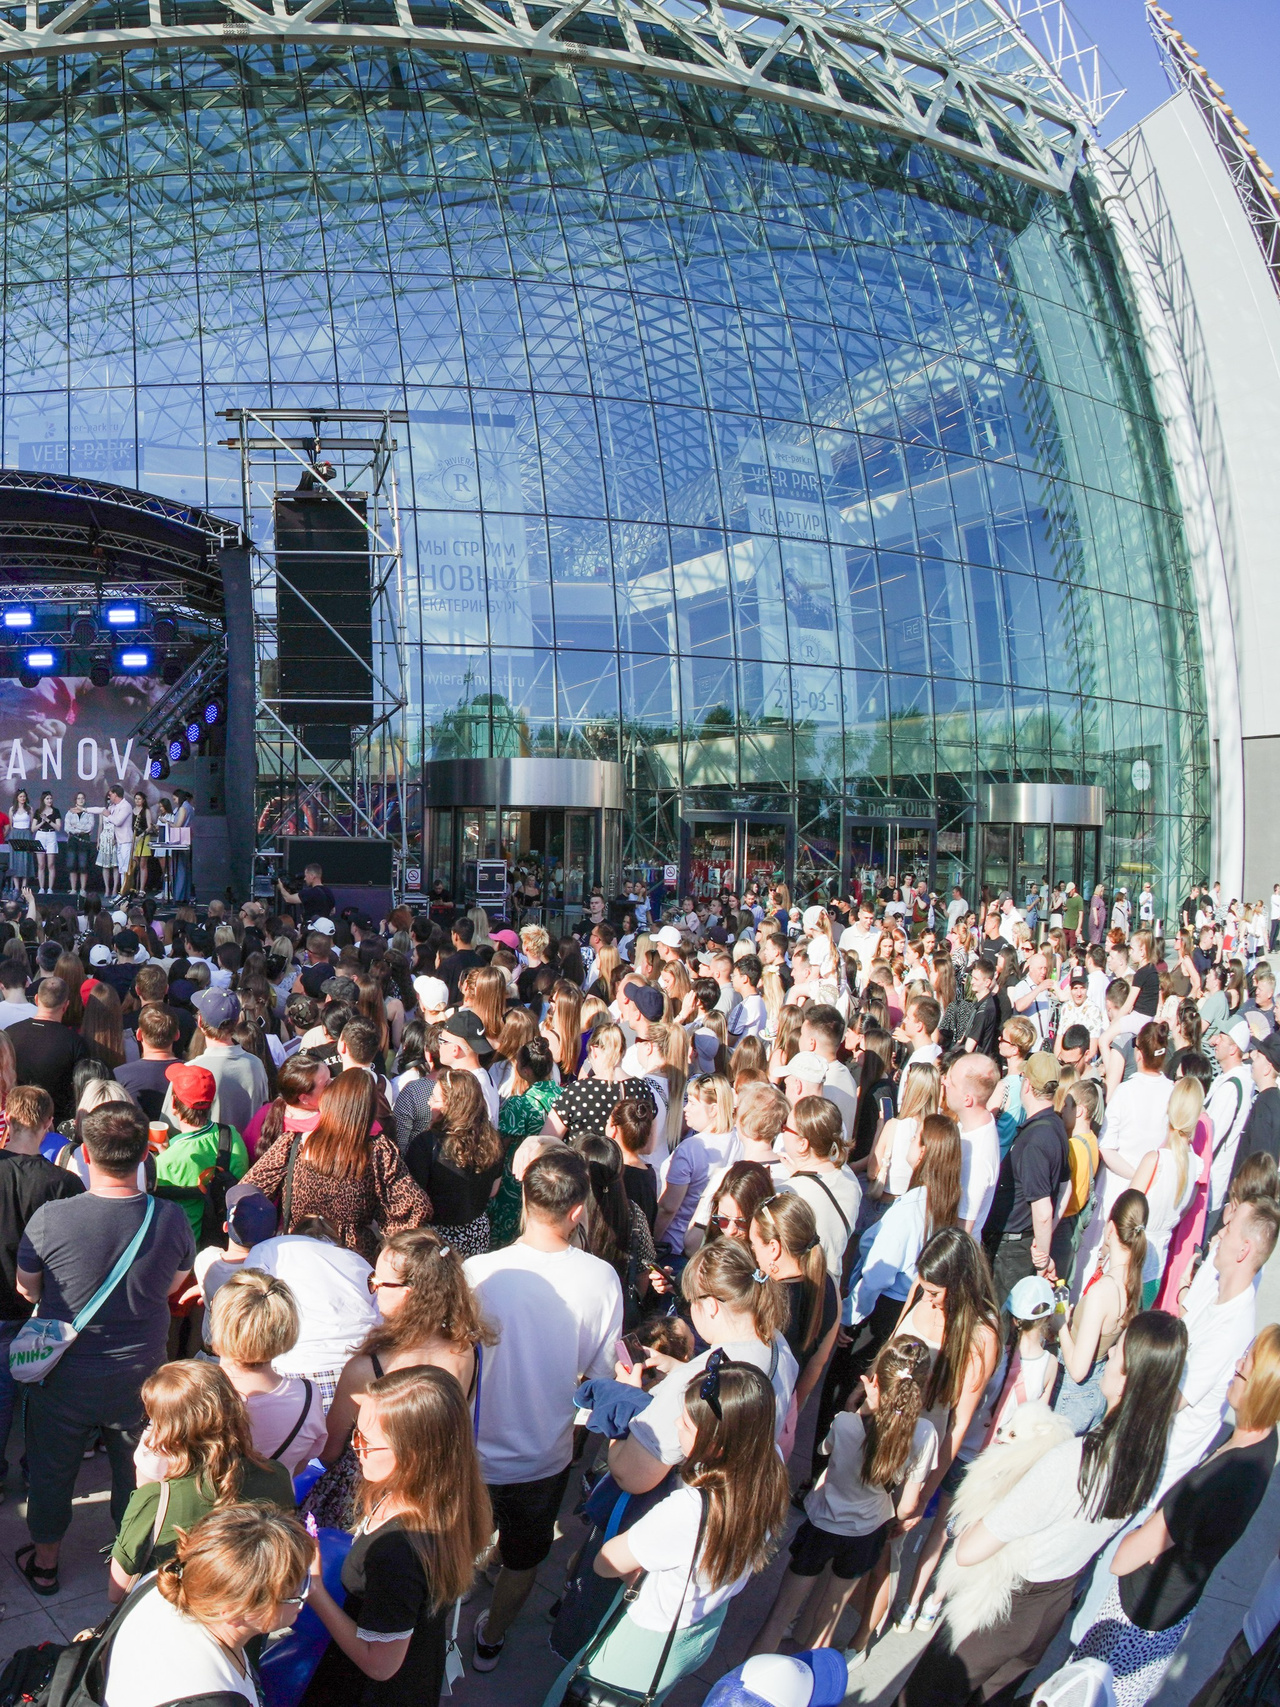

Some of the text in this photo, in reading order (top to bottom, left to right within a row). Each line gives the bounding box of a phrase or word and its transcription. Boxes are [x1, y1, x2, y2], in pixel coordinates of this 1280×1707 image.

[32, 441, 131, 462] VEER PARK
[453, 473, 471, 492] R
[751, 466, 787, 488] VEER
[419, 539, 516, 558] МЫ СТРОИМ
[421, 562, 517, 593] НОВЫЙ
[806, 645, 815, 658] R
